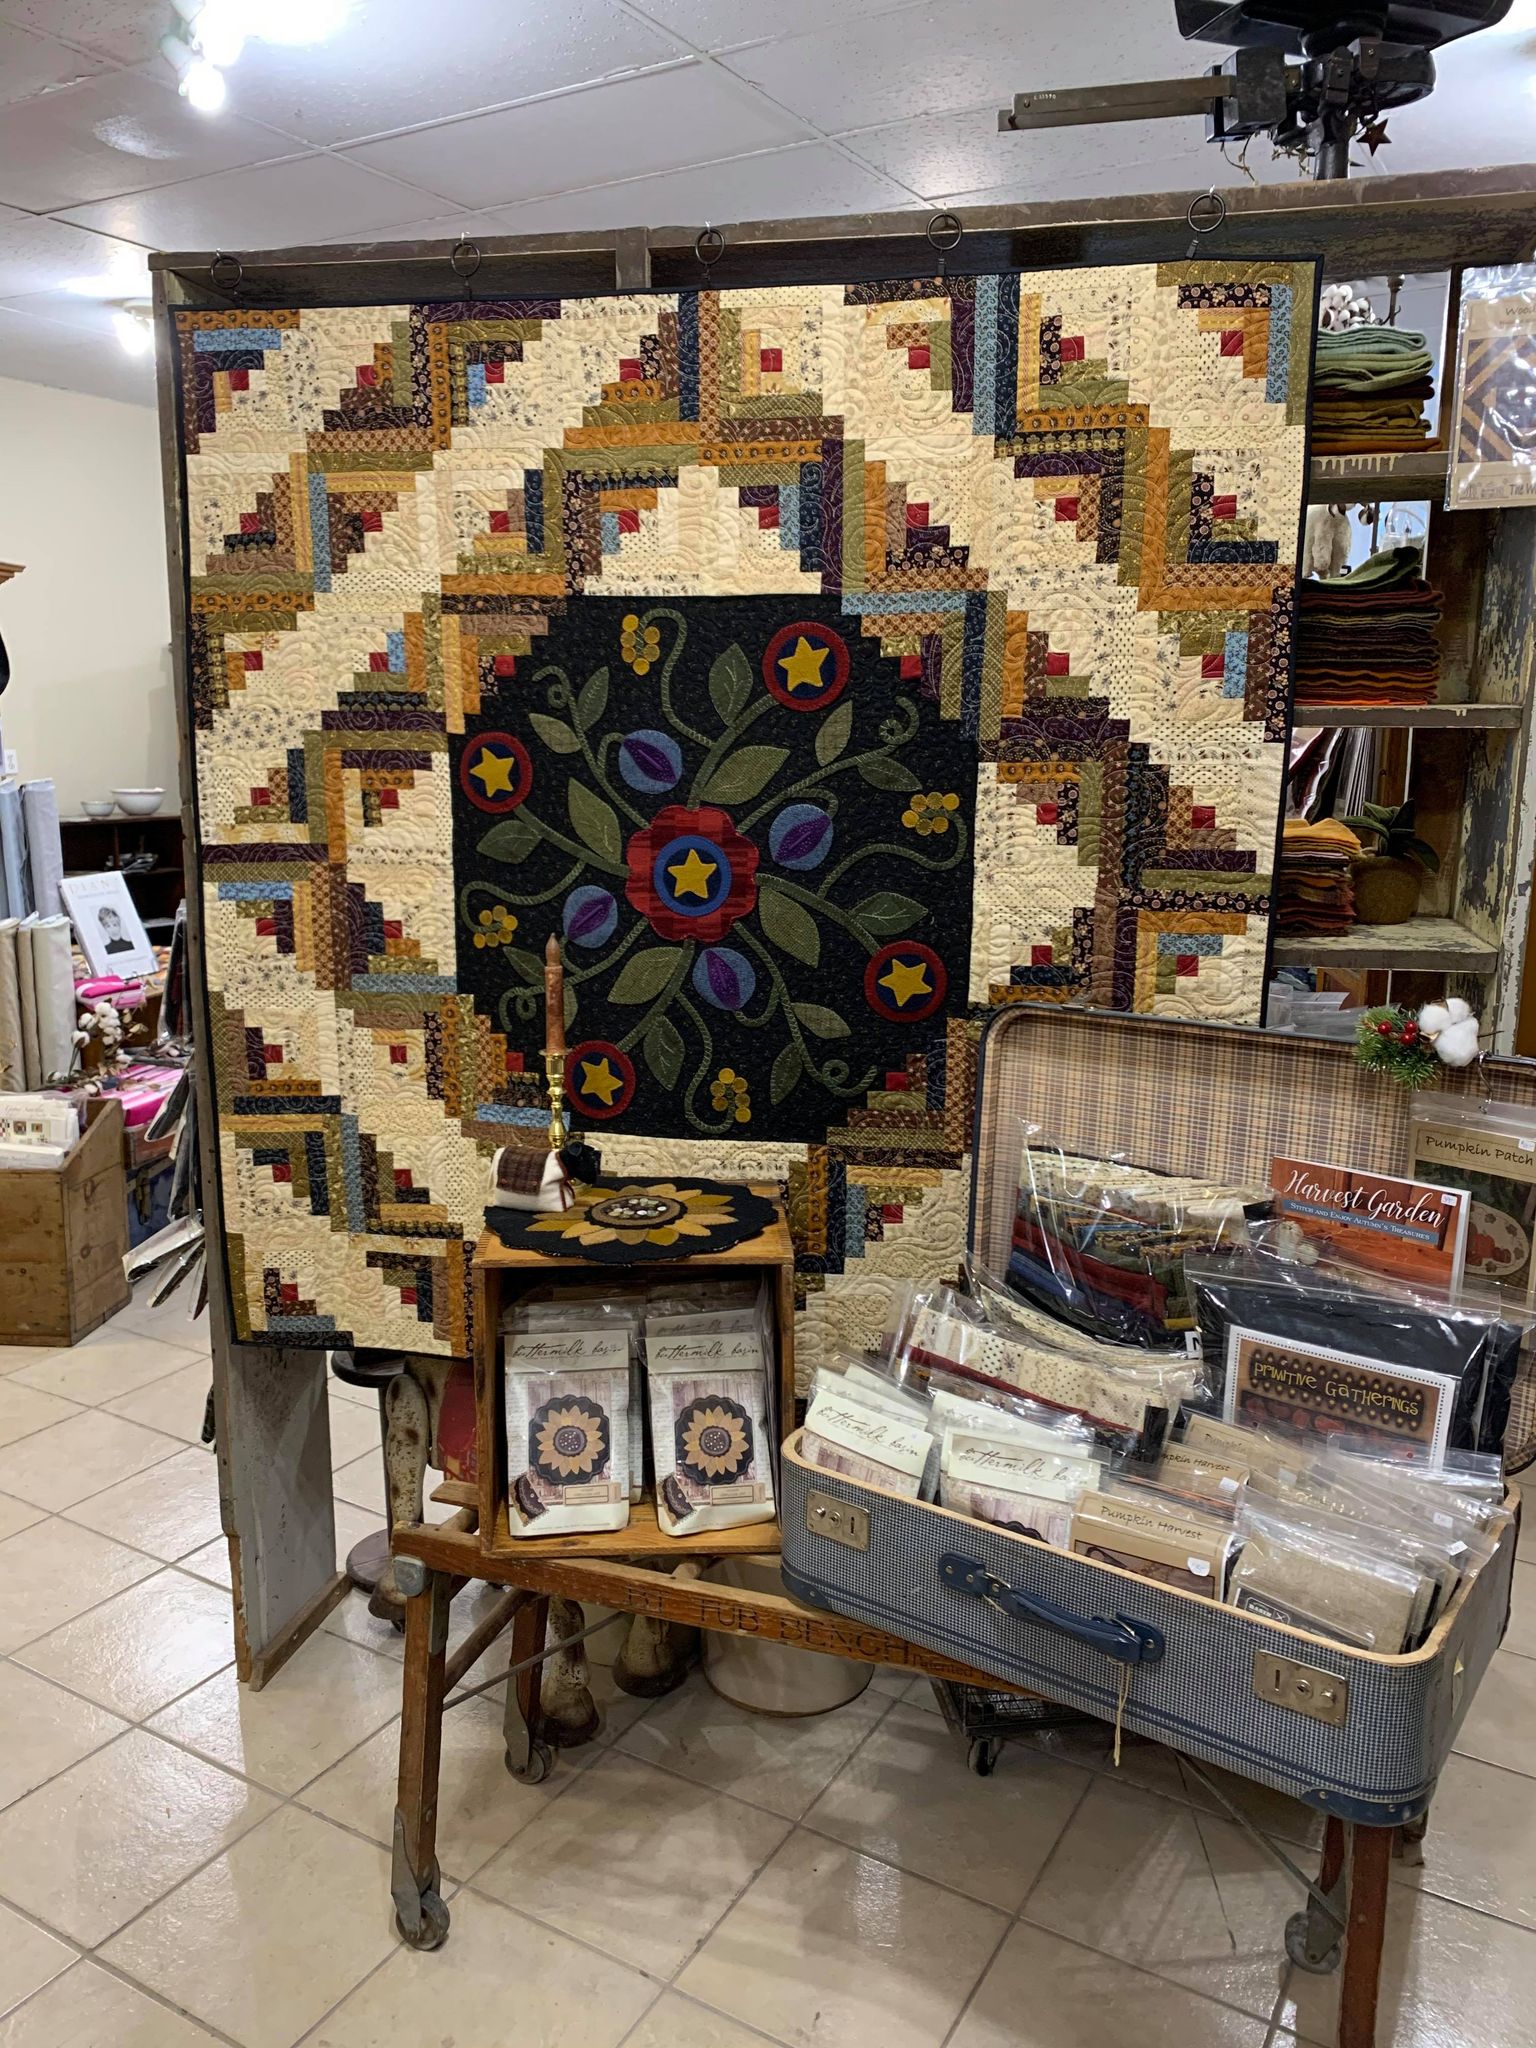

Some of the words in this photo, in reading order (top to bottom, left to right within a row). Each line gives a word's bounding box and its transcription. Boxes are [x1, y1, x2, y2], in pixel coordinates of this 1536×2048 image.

[1425, 1135, 1491, 1157] Pumpkin
[1495, 1148, 1534, 1166] Patch
[1284, 1169, 1370, 1209] Harvest
[1367, 1189, 1445, 1228] Garden
[1101, 1504, 1154, 1530] Pumpkin
[1157, 1520, 1204, 1541] Harvest
